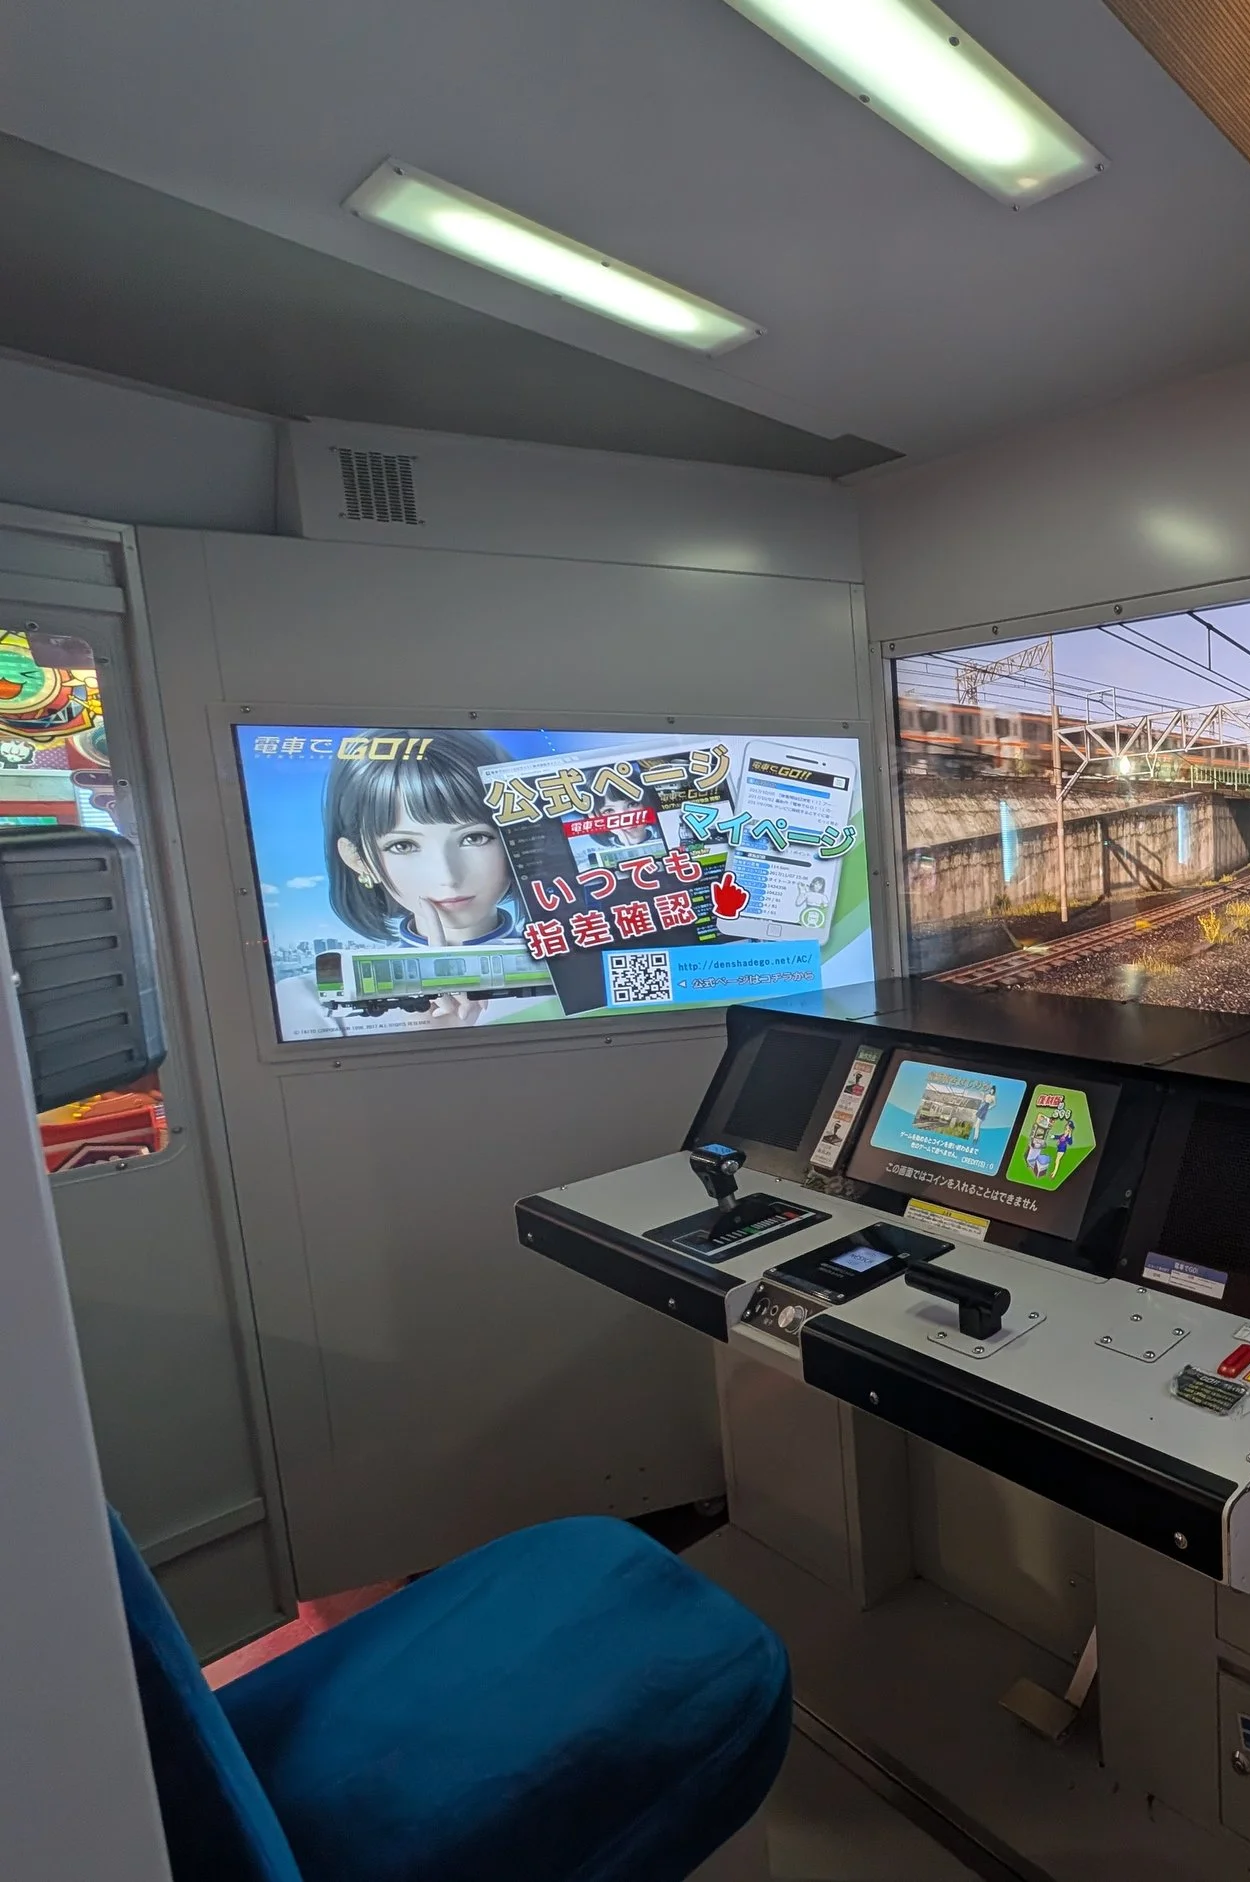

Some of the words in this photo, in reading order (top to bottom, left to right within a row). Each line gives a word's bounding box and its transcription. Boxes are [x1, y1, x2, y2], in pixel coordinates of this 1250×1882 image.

[253, 736, 433, 761] 電車でGO!!
[485, 744, 730, 826] 公式ページ
[571, 810, 648, 832] 電車でGO!!
[682, 802, 857, 859] マイページ
[531, 849, 702, 912] いつでも
[523, 890, 697, 960] 指差確認
[678, 954, 813, 971] http://denshadego.net/AC/
[692, 971, 816, 989] 公式ページはコチラから
[885, 1162, 1038, 1212] この画面ではコインを入れることはできません
